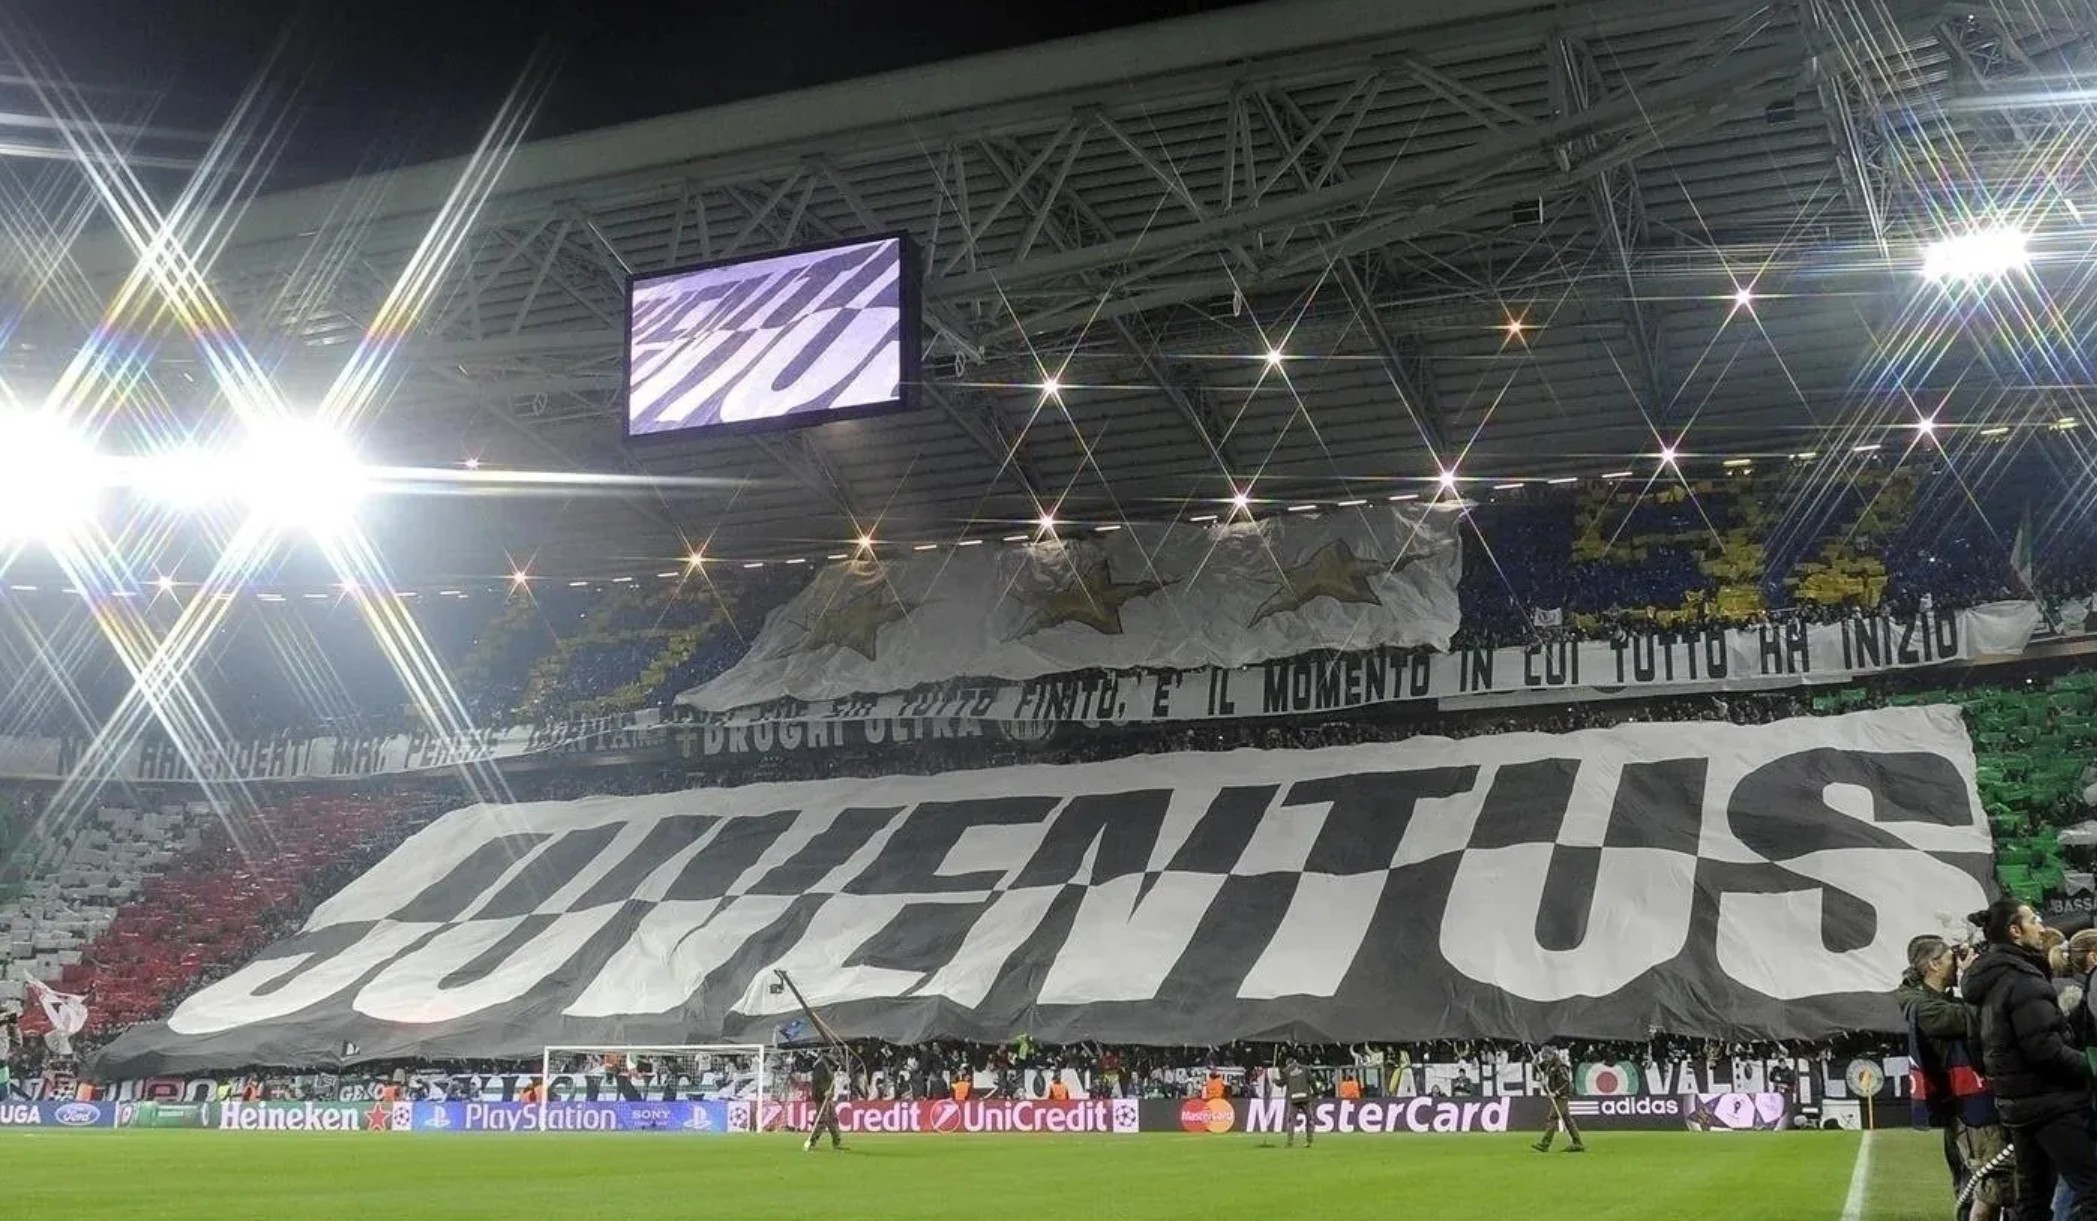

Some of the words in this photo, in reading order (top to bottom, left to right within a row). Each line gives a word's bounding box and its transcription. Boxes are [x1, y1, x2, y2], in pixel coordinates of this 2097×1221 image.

[1208, 668, 1235, 716] IL
[1263, 652, 1430, 713] MOMENTO
[1460, 648, 1493, 692] IN
[1524, 641, 1578, 687] CUI
[1609, 630, 1727, 683] TUTTO
[1759, 624, 1809, 674] HA
[1840, 607, 1957, 670] INIZIO
[167, 746, 1991, 1035] JUVENTUS
[62, 1109, 91, 1124] Ford
[220, 1101, 360, 1130] Heineken
[465, 1103, 616, 1131] PlaySation
[632, 1110, 670, 1120] SONY
[963, 1102, 1107, 1133] UniCredit
[1601, 1097, 1679, 1115] adidas
